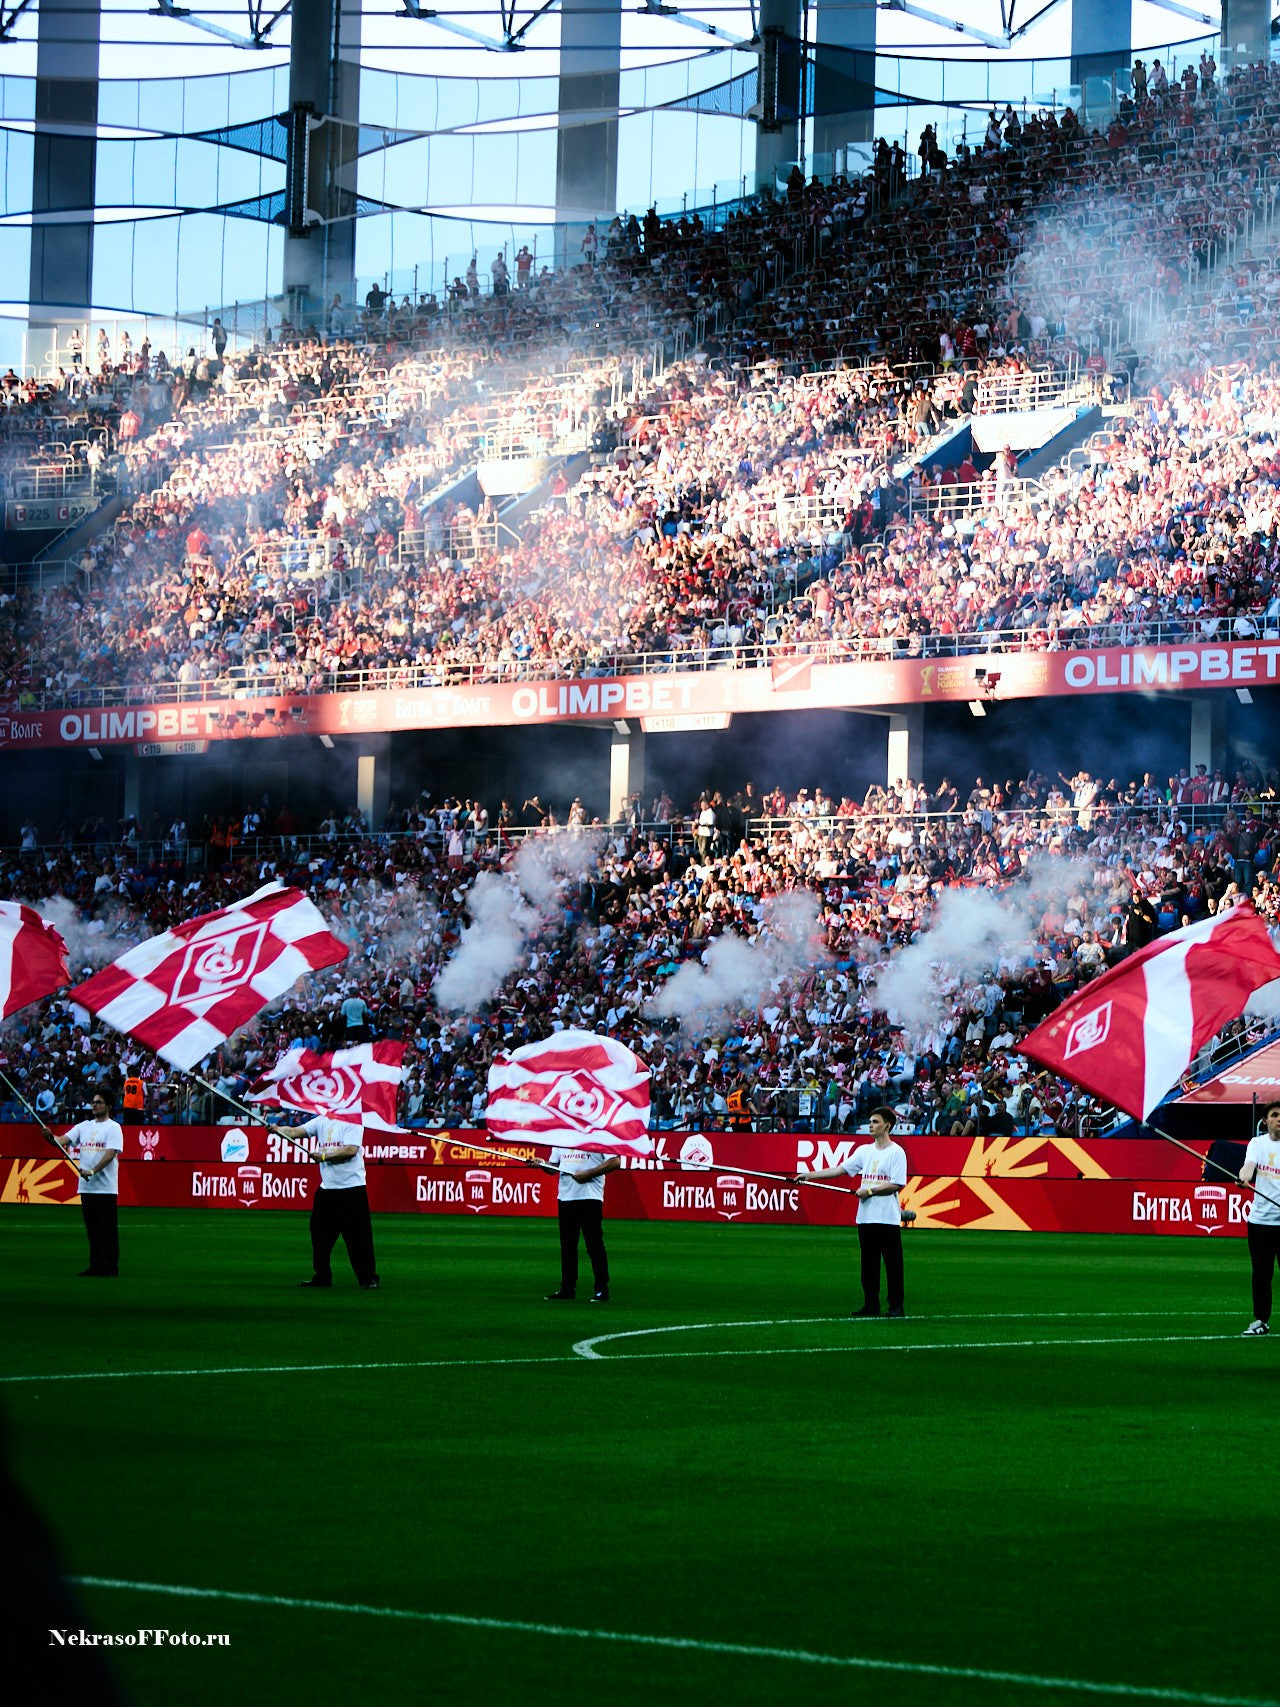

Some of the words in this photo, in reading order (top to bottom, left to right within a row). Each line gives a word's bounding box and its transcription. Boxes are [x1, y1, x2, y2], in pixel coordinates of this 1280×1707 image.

[29, 508, 50, 521] 225
[71, 506, 88, 518] 22
[511, 678, 699, 718] OLIMPBET
[60, 706, 219, 741] OLIMPBET
[149, 744, 161, 754] 119
[184, 742, 196, 752] 118
[192, 1171, 237, 1197] Битва
[262, 1172, 308, 1198] Волге
[416, 1175, 465, 1202] Битва
[492, 1177, 542, 1204] Волге
[663, 1180, 715, 1209] Битва
[746, 1183, 799, 1211] Волге
[1132, 1191, 1193, 1222] Битва
